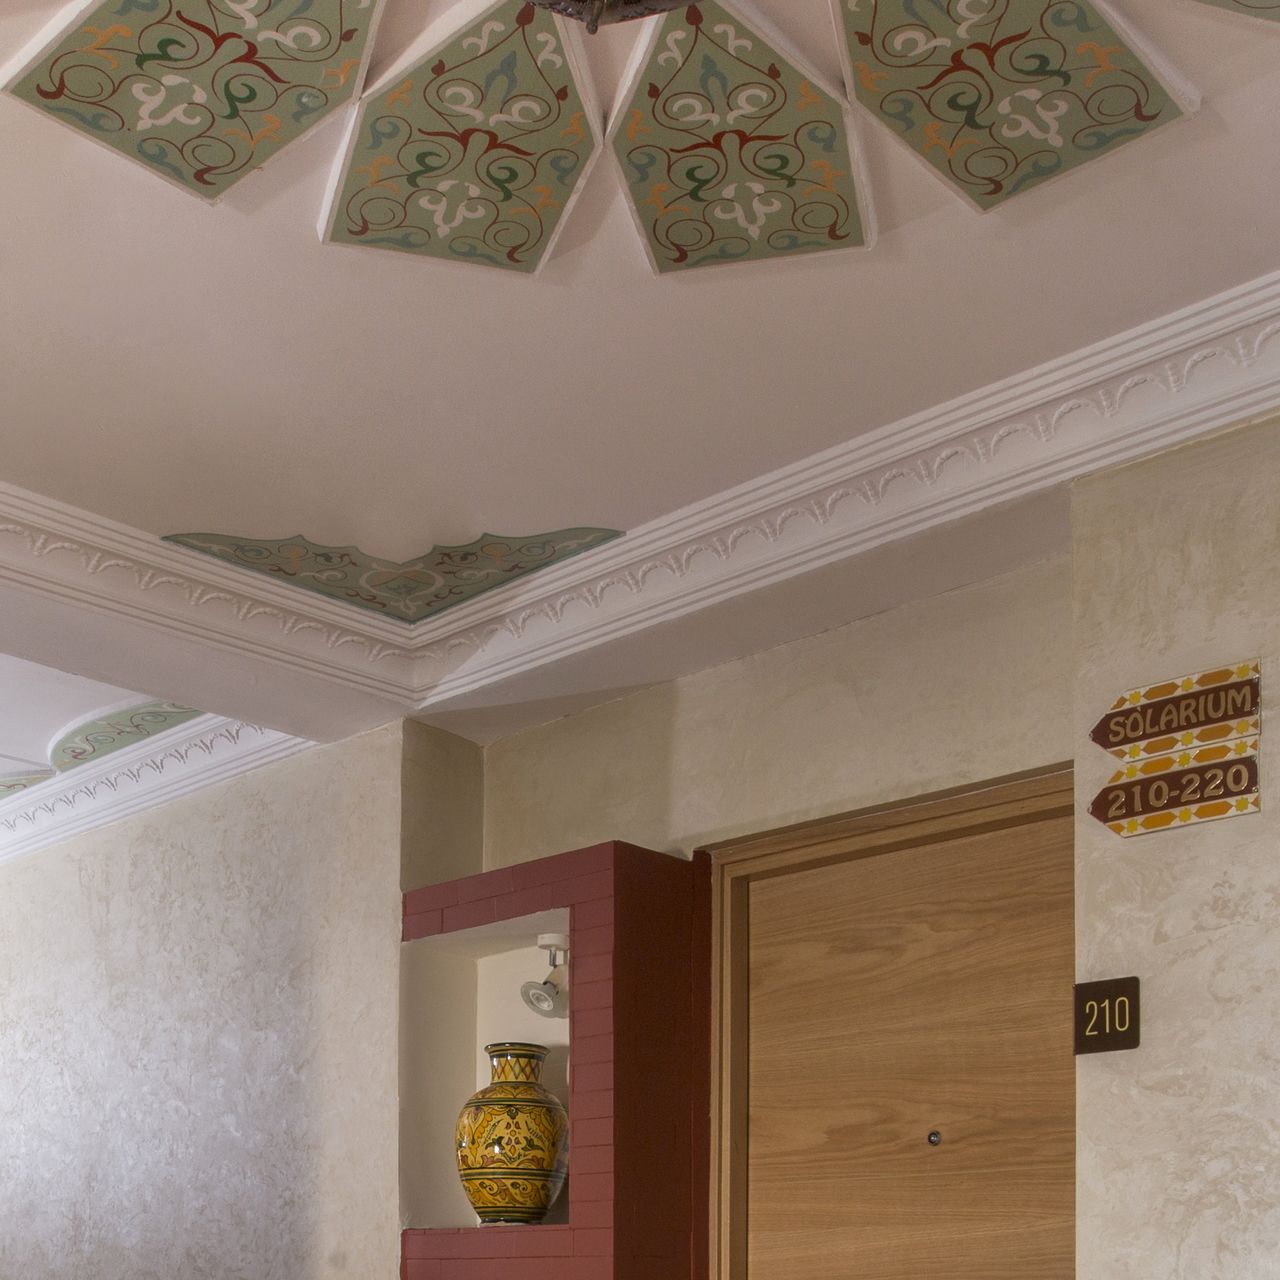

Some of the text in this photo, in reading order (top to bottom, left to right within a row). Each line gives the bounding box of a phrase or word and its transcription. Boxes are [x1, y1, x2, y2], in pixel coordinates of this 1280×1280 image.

[1108, 685, 1252, 743] SOLARIUM
[1107, 764, 1249, 818] 210-220
[1085, 996, 1130, 1036] 210
